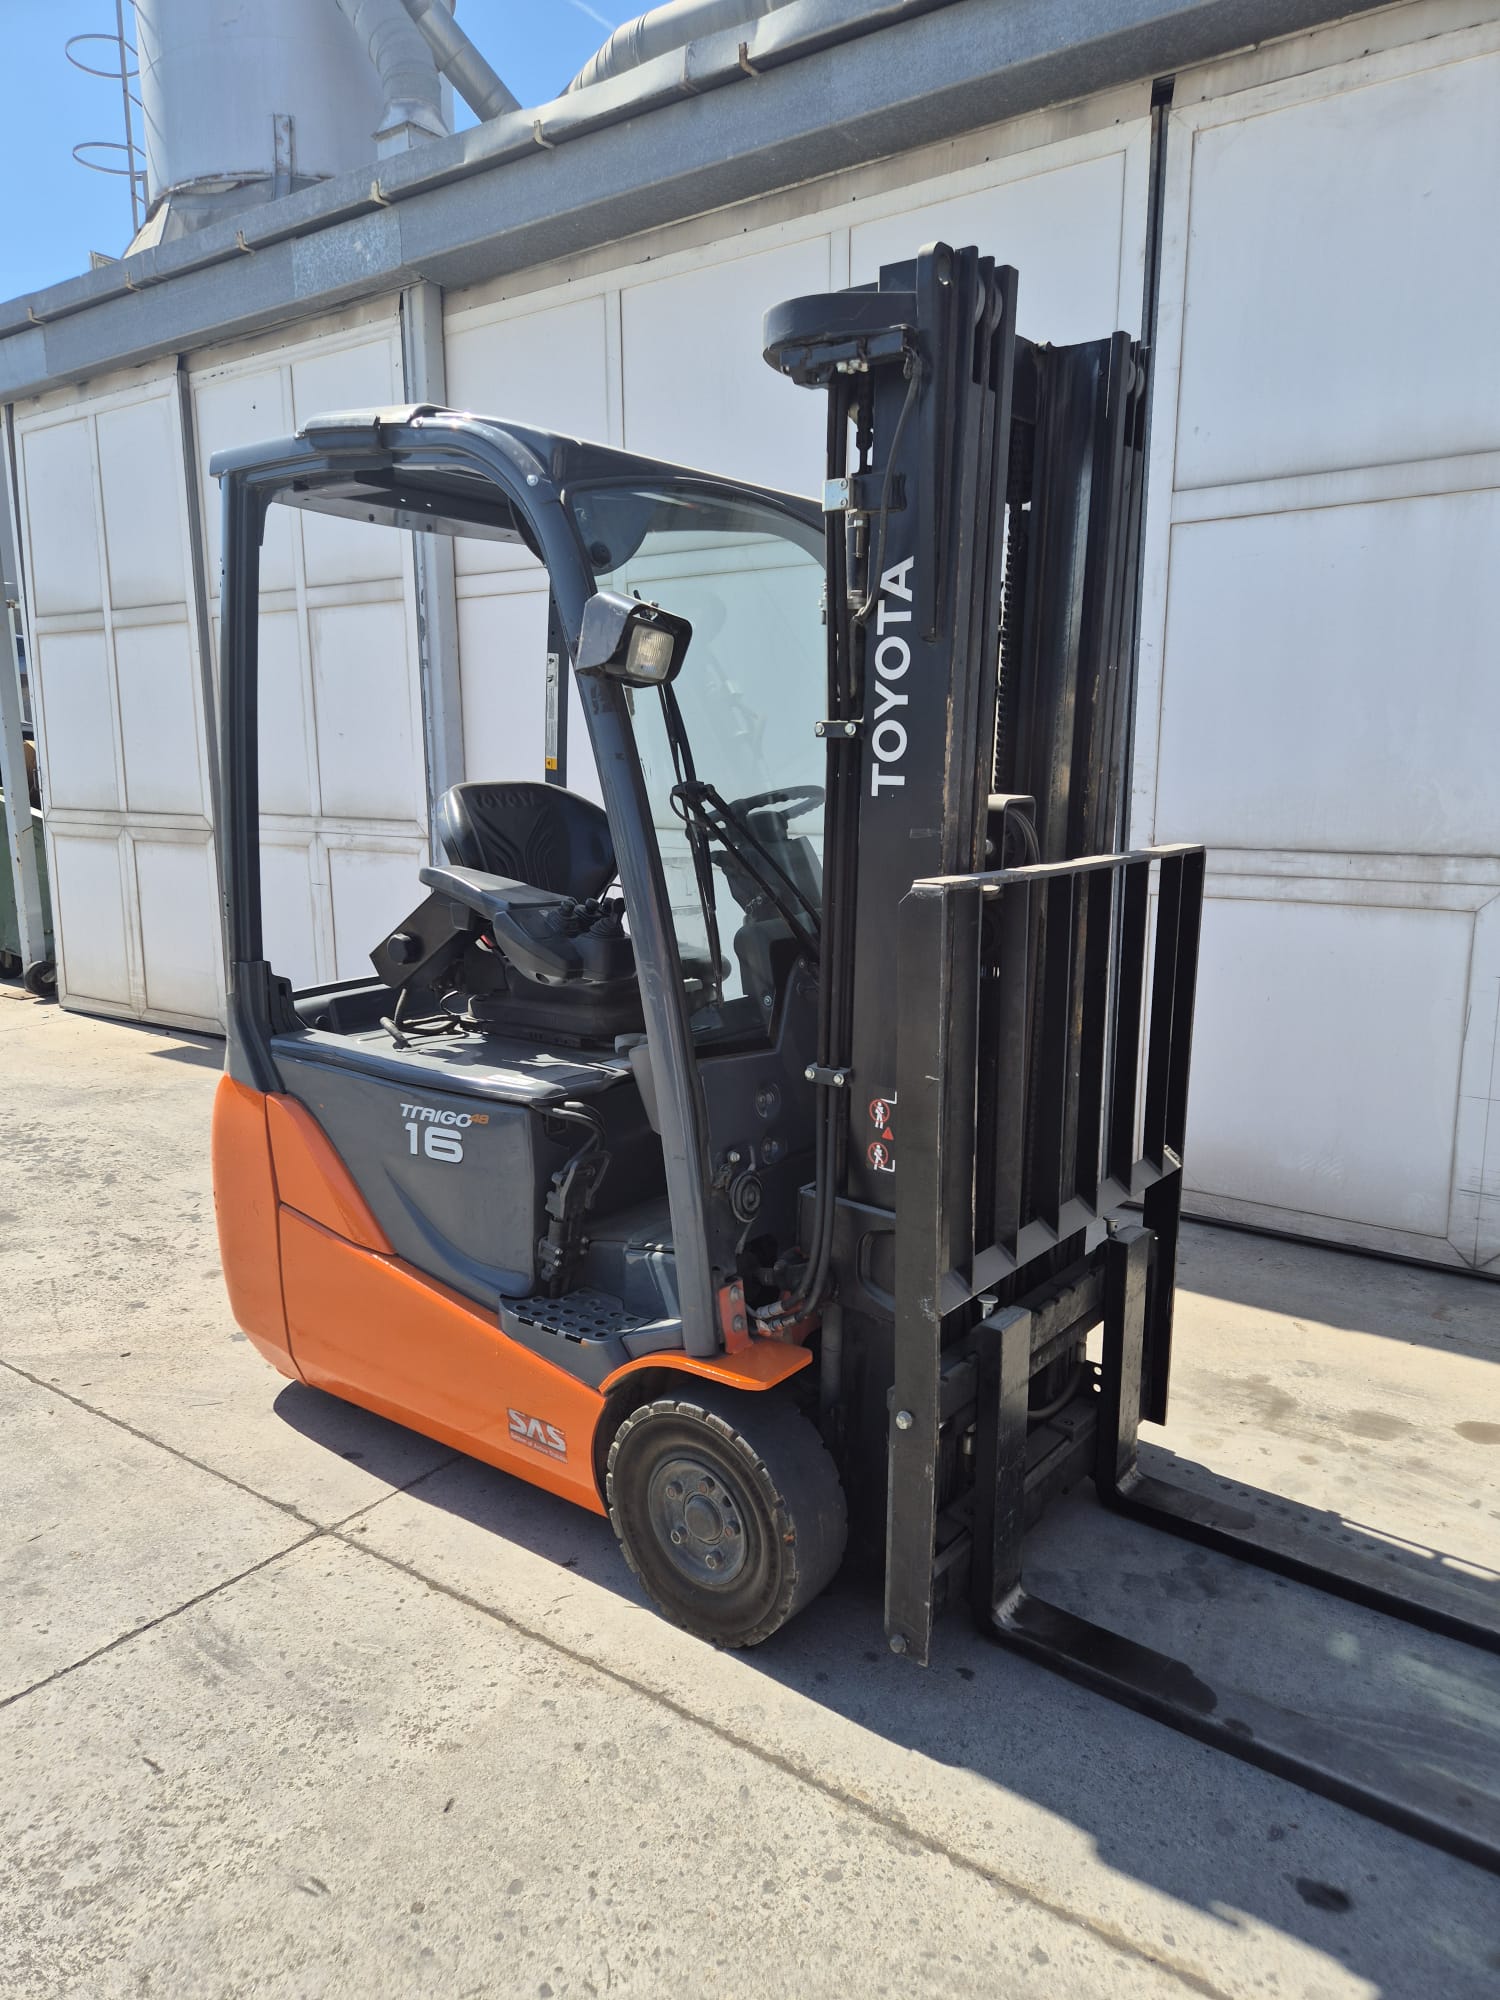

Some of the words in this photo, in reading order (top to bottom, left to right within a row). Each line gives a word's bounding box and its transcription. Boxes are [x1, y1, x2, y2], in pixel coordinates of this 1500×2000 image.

[870, 555, 915, 797] TOYOTA
[404, 1122, 464, 1163] 16
[508, 1407, 566, 1452] SAS
